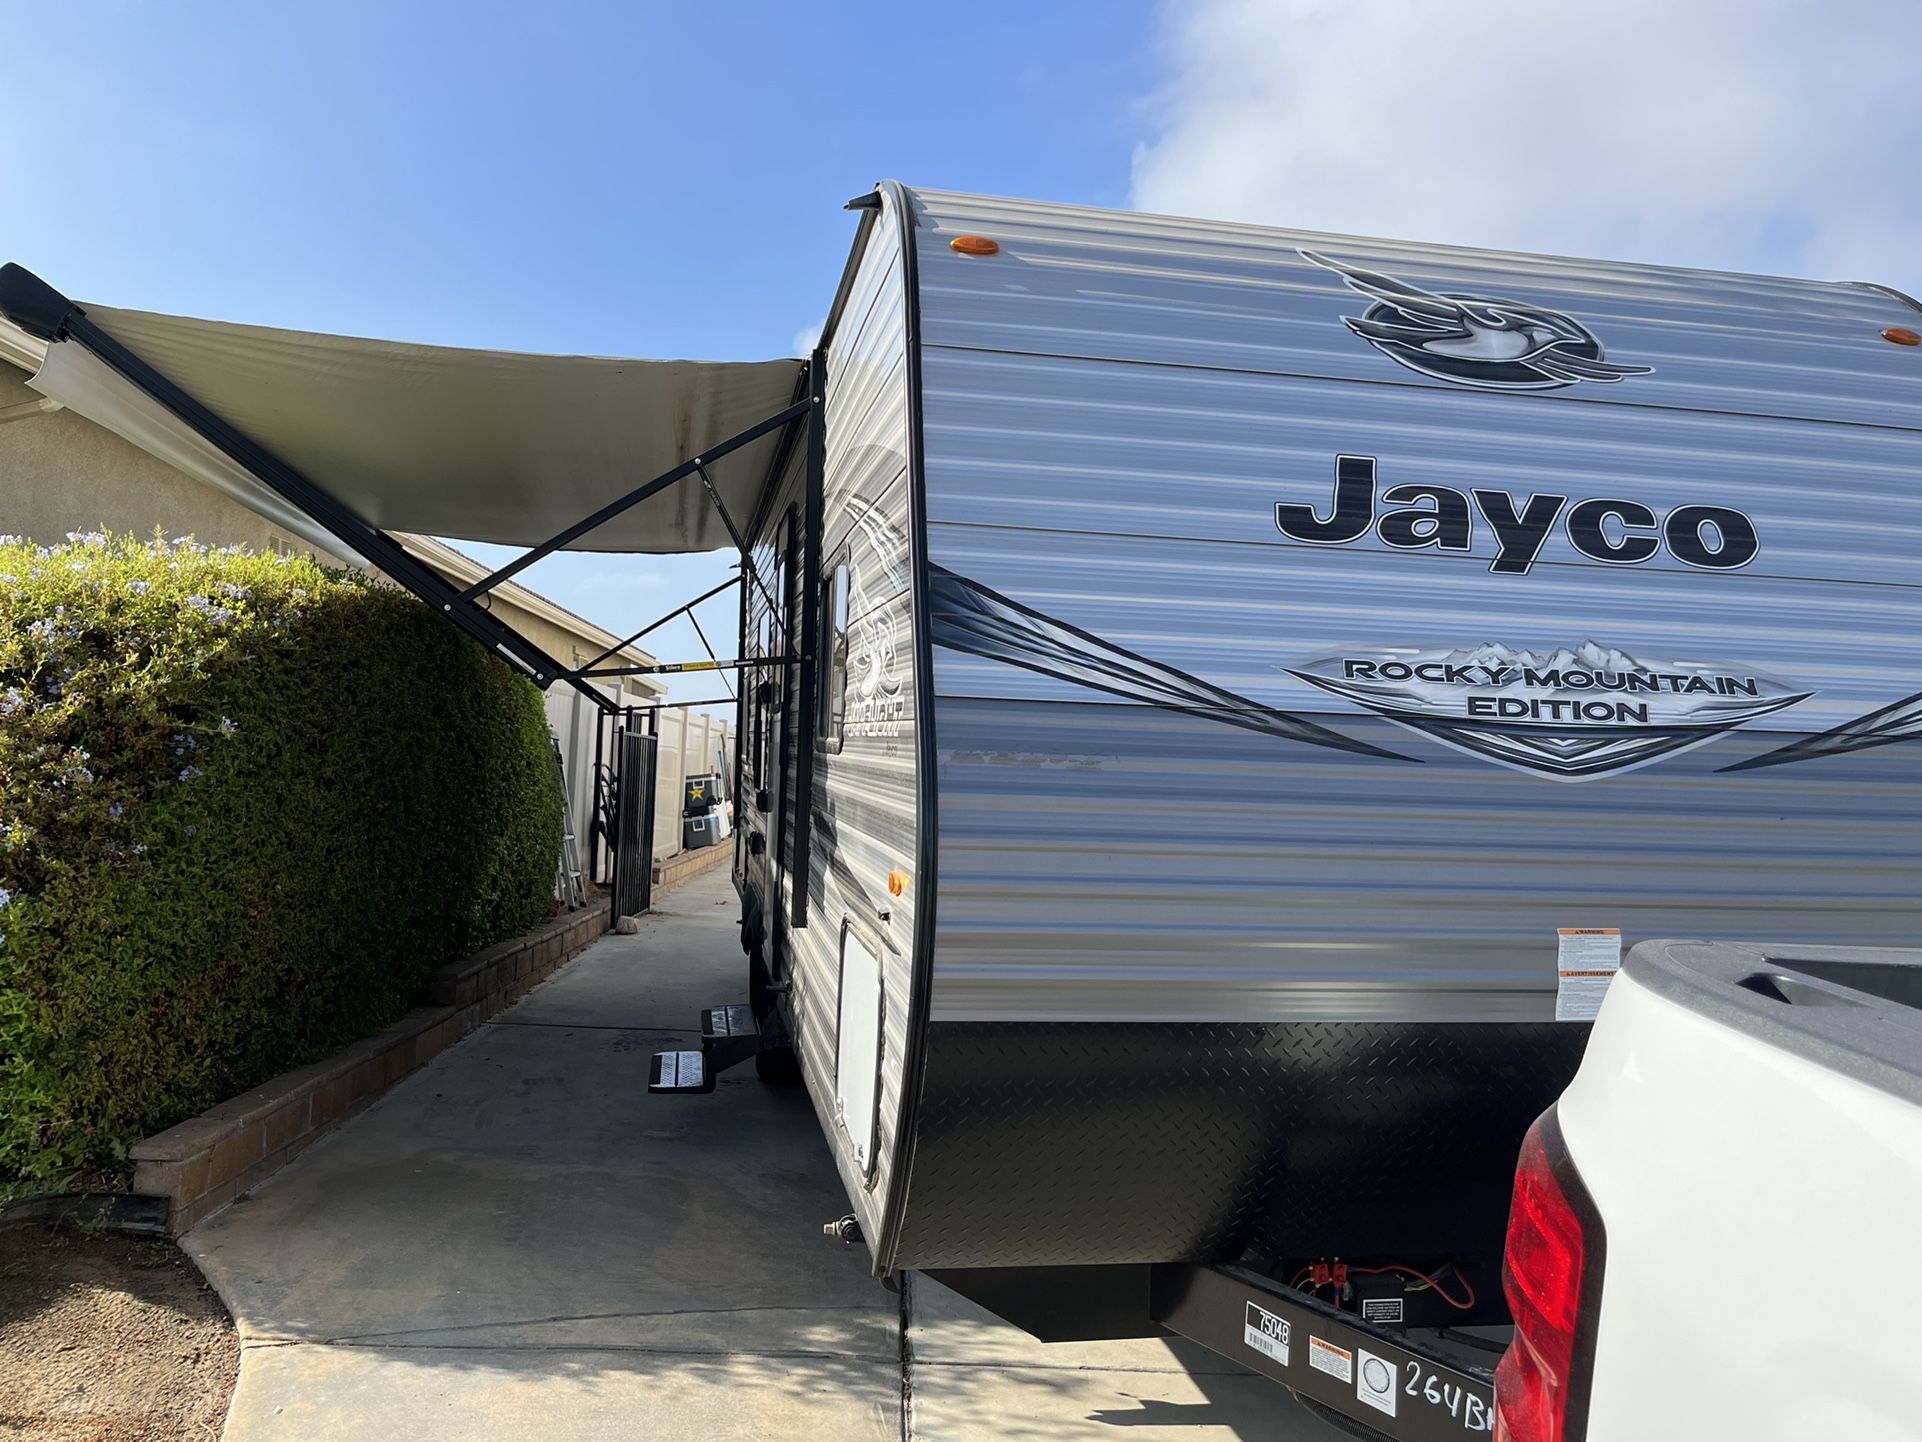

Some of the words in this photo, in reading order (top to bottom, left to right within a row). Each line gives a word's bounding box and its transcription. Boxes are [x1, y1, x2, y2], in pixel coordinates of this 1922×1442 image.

[1274, 454, 1760, 575] Jayco
[1342, 658, 1509, 687] ROCKY
[1523, 667, 1759, 697] MOUNTAIN
[1466, 696, 1650, 723] EDITION
[1259, 1311, 1289, 1345] 75048
